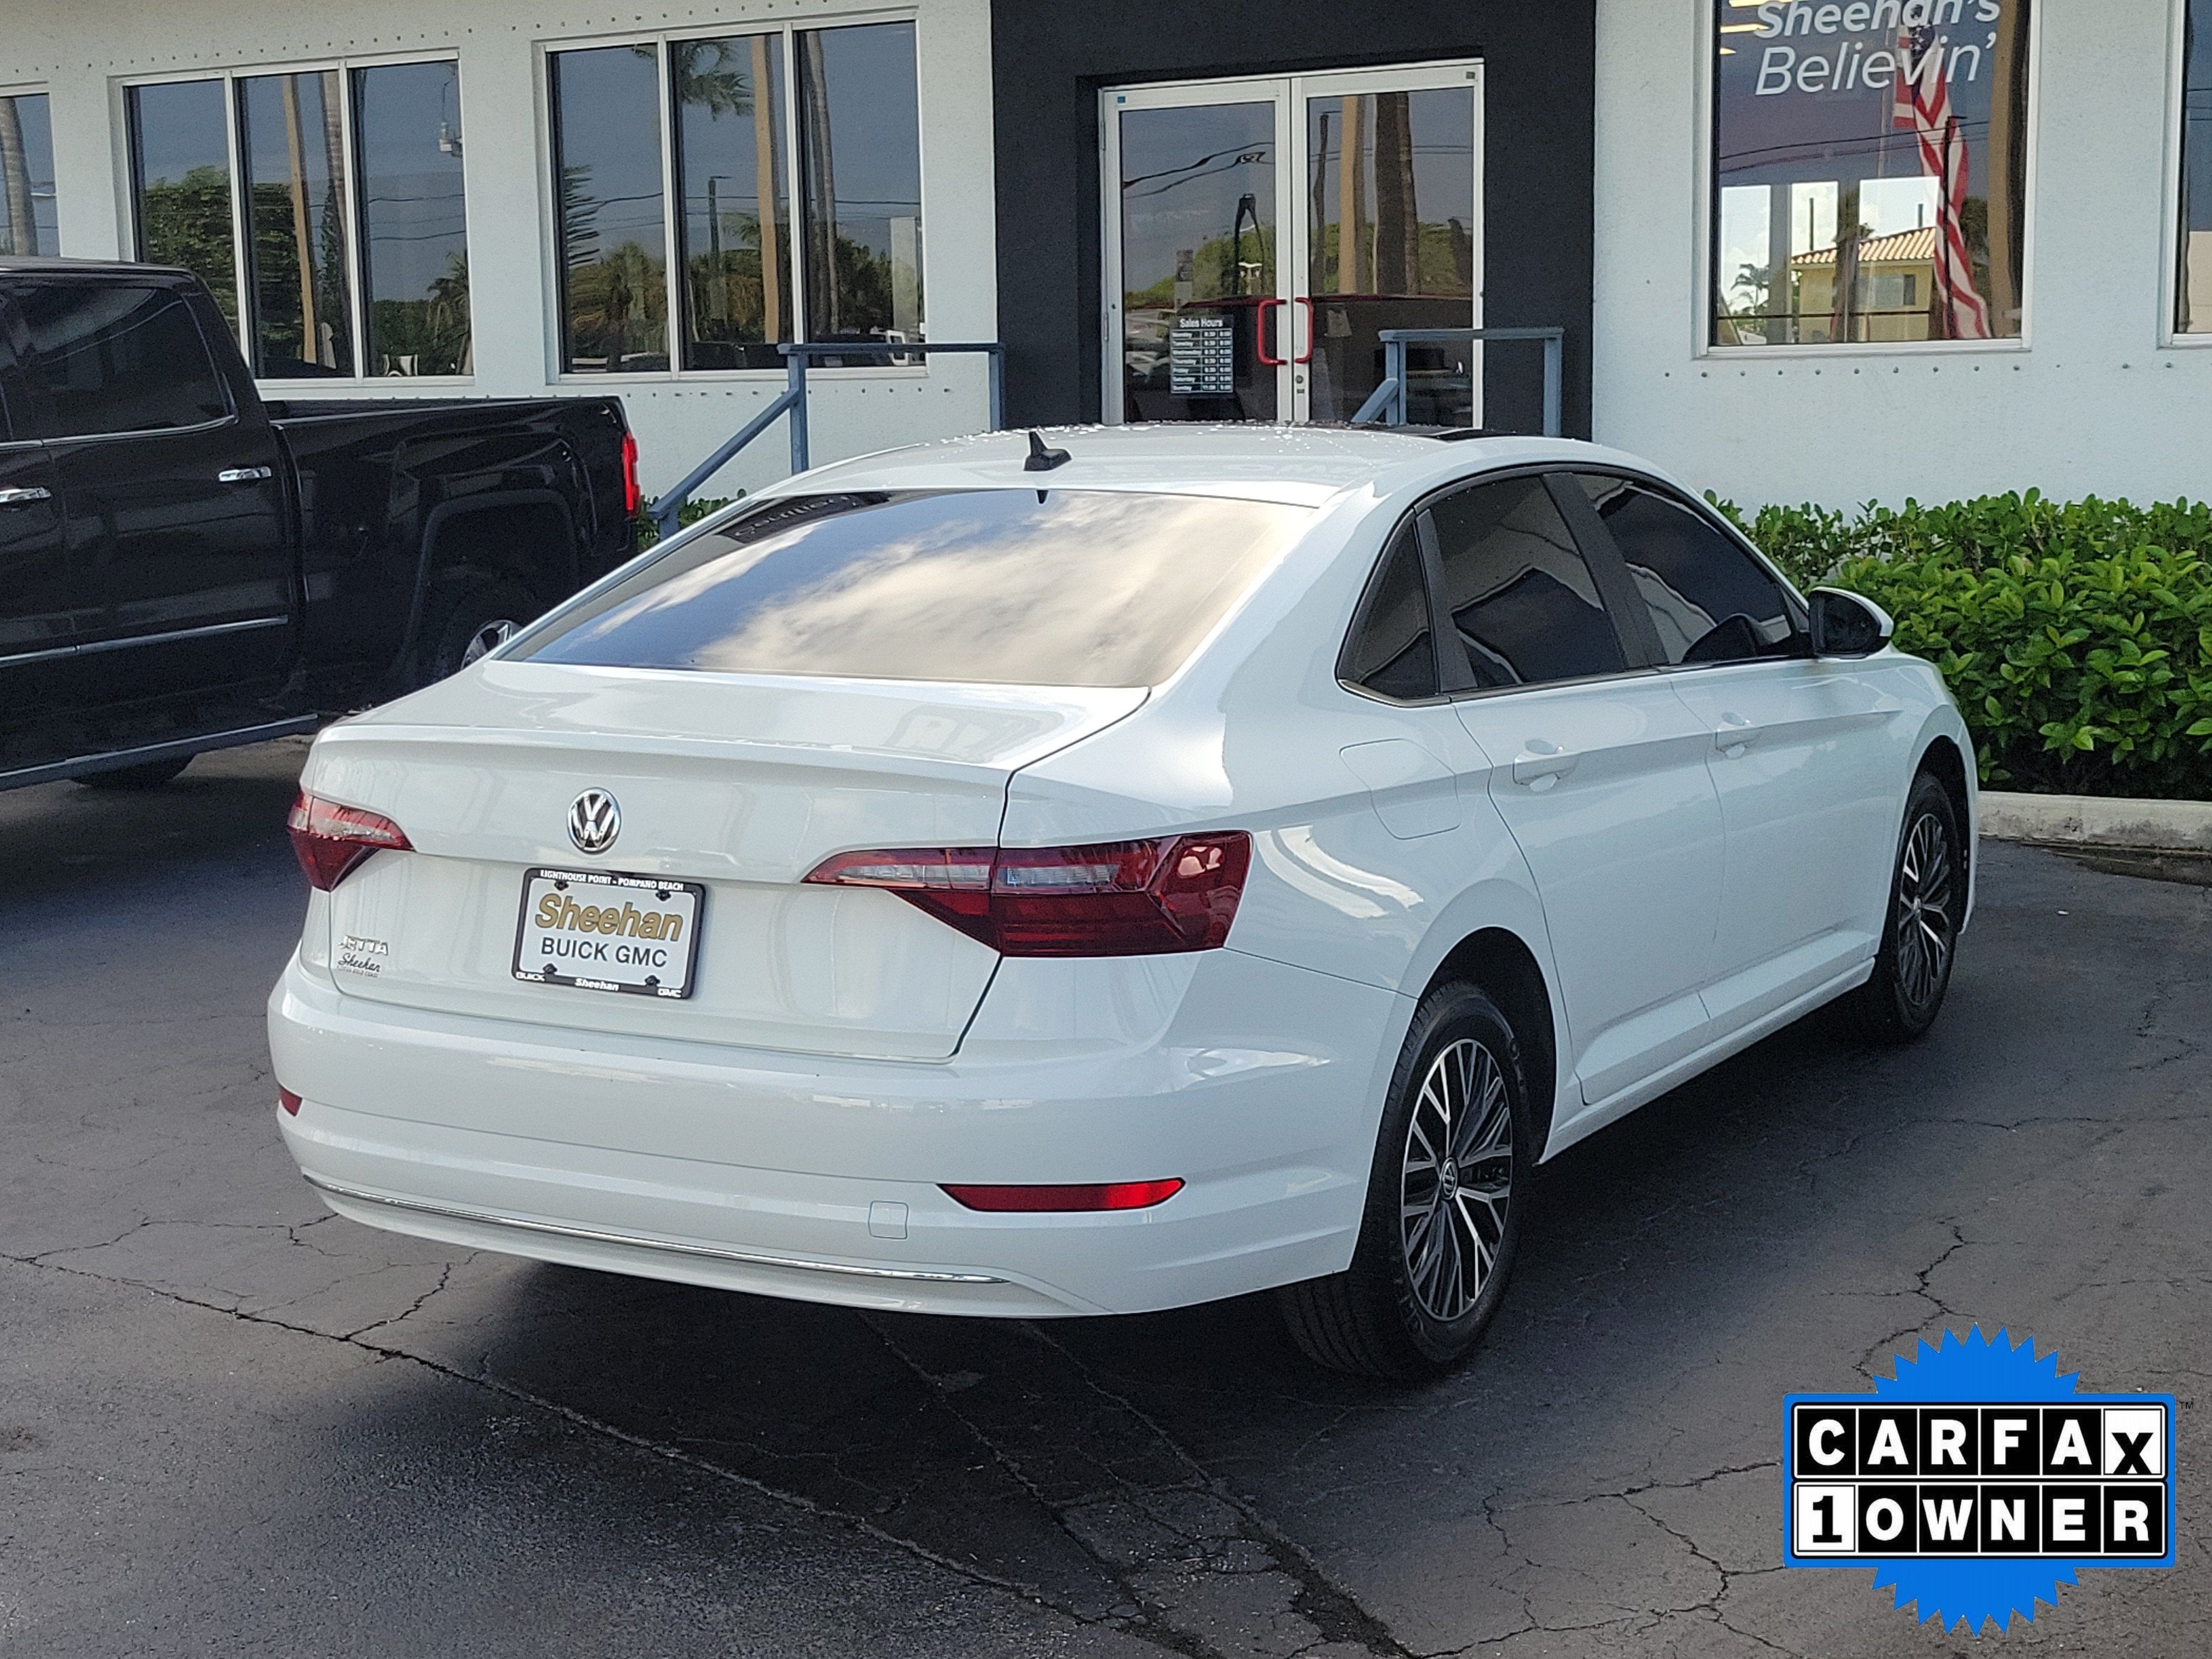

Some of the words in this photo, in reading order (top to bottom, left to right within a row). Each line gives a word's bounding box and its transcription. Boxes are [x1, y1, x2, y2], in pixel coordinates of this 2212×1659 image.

[1754, 0, 2000, 38] Sheehan's
[1755, 32, 1997, 95] Believin'
[1180, 318, 1200, 328] Sales
[1201, 318, 1223, 327] Hours
[540, 870, 586, 882] LIGHTHOUSE
[588, 875, 612, 884] POINT
[618, 878, 657, 889] POMPANO
[658, 881, 684, 890] BEACH
[535, 893, 684, 942] Sheehan
[541, 937, 609, 961] BUICK
[616, 945, 668, 967] GMC
[575, 978, 619, 991] Sheehan
[658, 988, 682, 998] GMC
